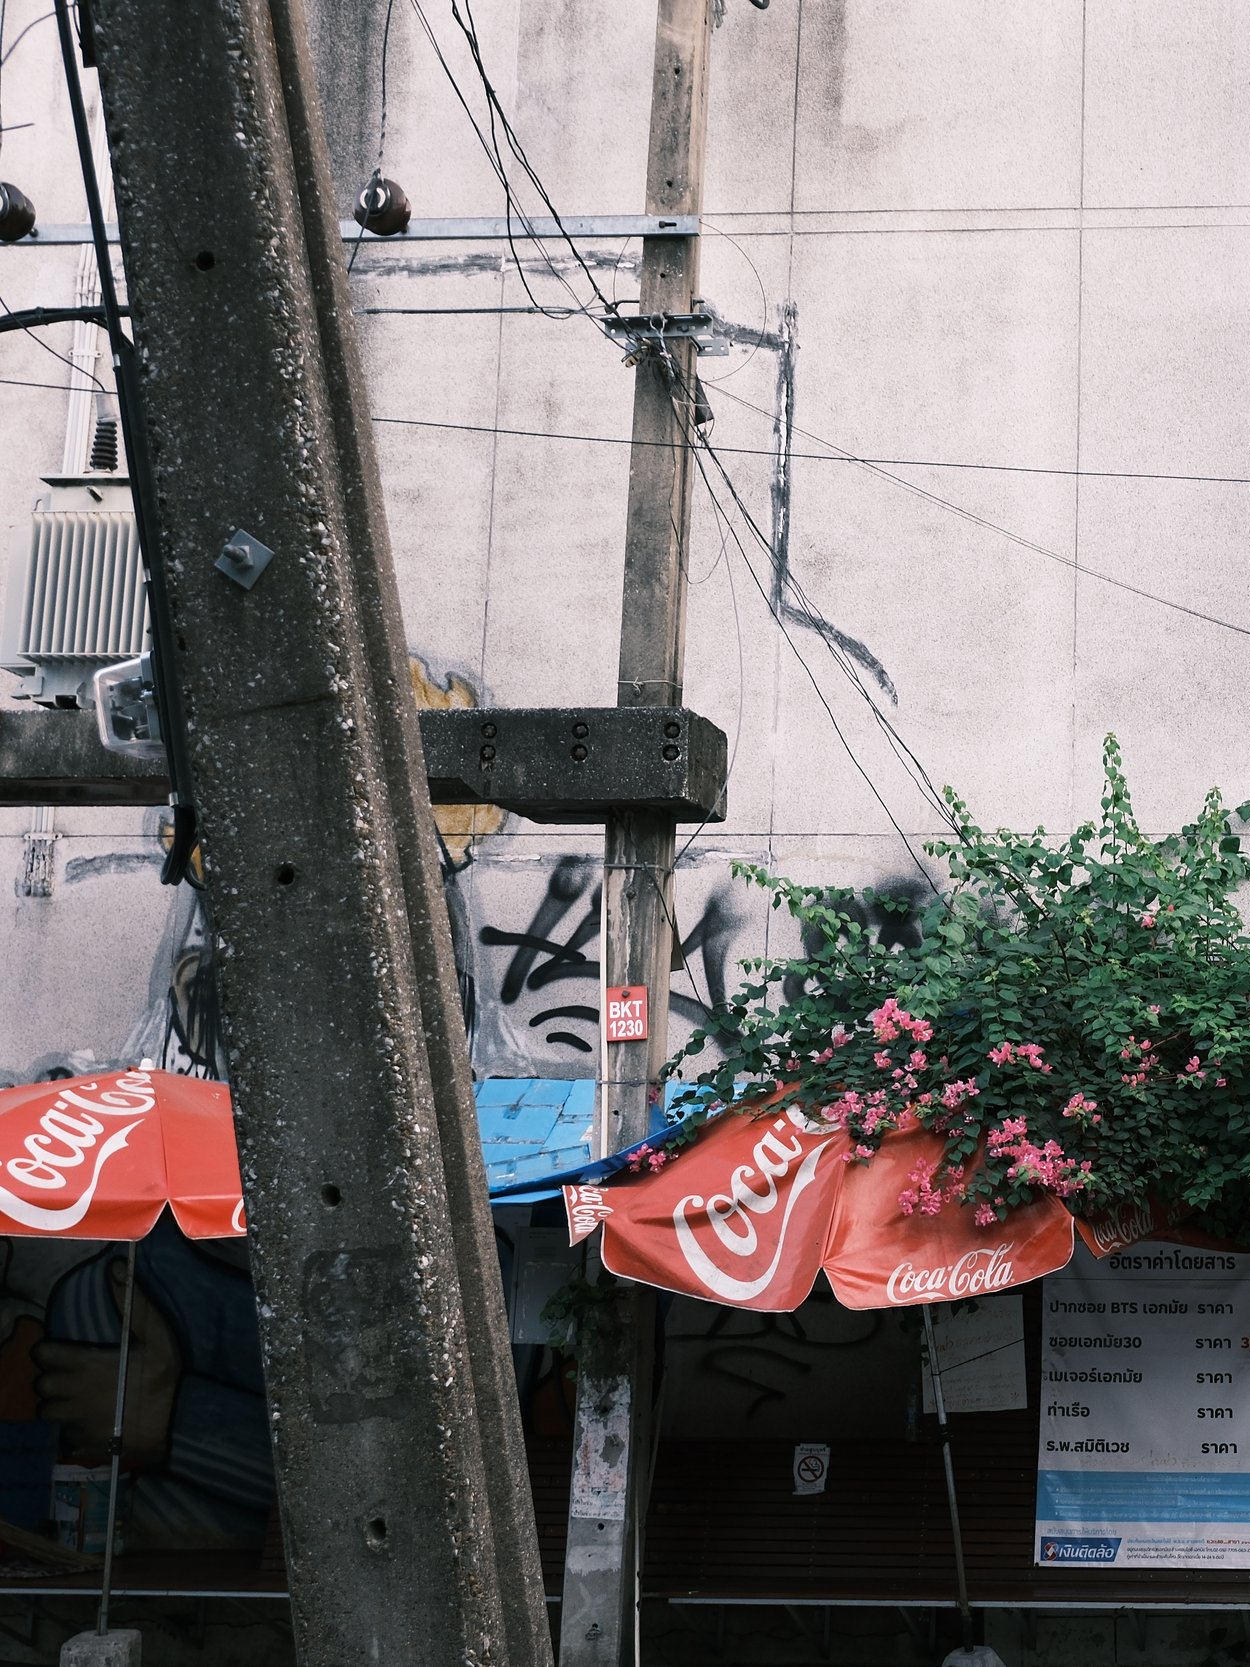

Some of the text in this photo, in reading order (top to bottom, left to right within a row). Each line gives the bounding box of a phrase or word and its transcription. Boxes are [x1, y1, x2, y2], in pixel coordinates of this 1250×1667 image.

[609, 1000, 643, 1019] BKT
[609, 1019, 643, 1037] 1230
[886, 1240, 1015, 1304] Coca-Cola
[1049, 1302, 1107, 1315] ปากซอย
[1111, 1303, 1138, 1314] BTS
[1143, 1299, 1188, 1315] เอกมัย
[1197, 1303, 1234, 1315] ราคา
[1195, 1337, 1232, 1350] ราคา
[1196, 1372, 1233, 1384] ราคา
[1047, 1402, 1090, 1418] ท่าเรือ
[1197, 1406, 1233, 1419] ราคา
[1046, 1439, 1130, 1453] ร.พ.สมิติเวช
[1201, 1441, 1238, 1454] ราคา
[1059, 1543, 1114, 1561] เงินติดล้อ
